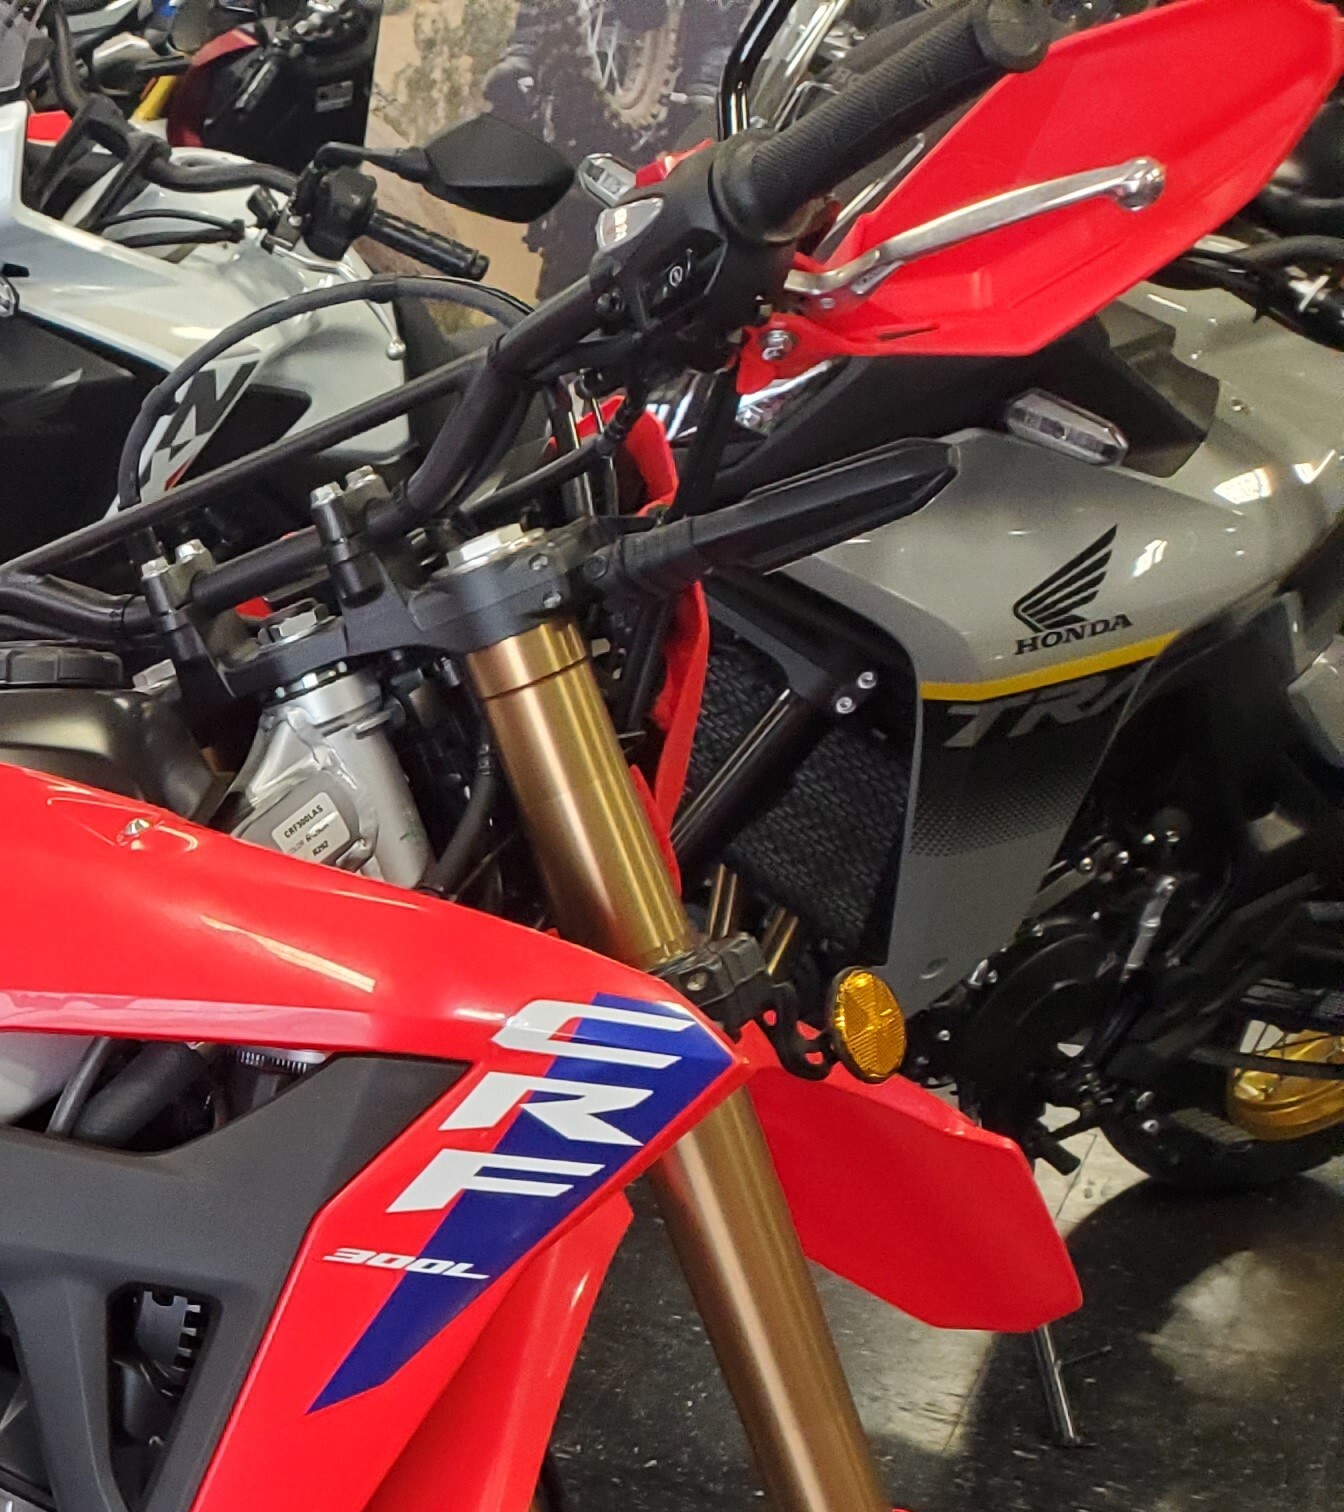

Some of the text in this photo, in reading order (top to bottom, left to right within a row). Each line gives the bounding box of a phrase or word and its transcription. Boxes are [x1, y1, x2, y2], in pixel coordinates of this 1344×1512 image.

[1014, 614, 1133, 655] HONDA
[386, 1000, 697, 1213] CRF
[323, 1247, 491, 1280] 300L
